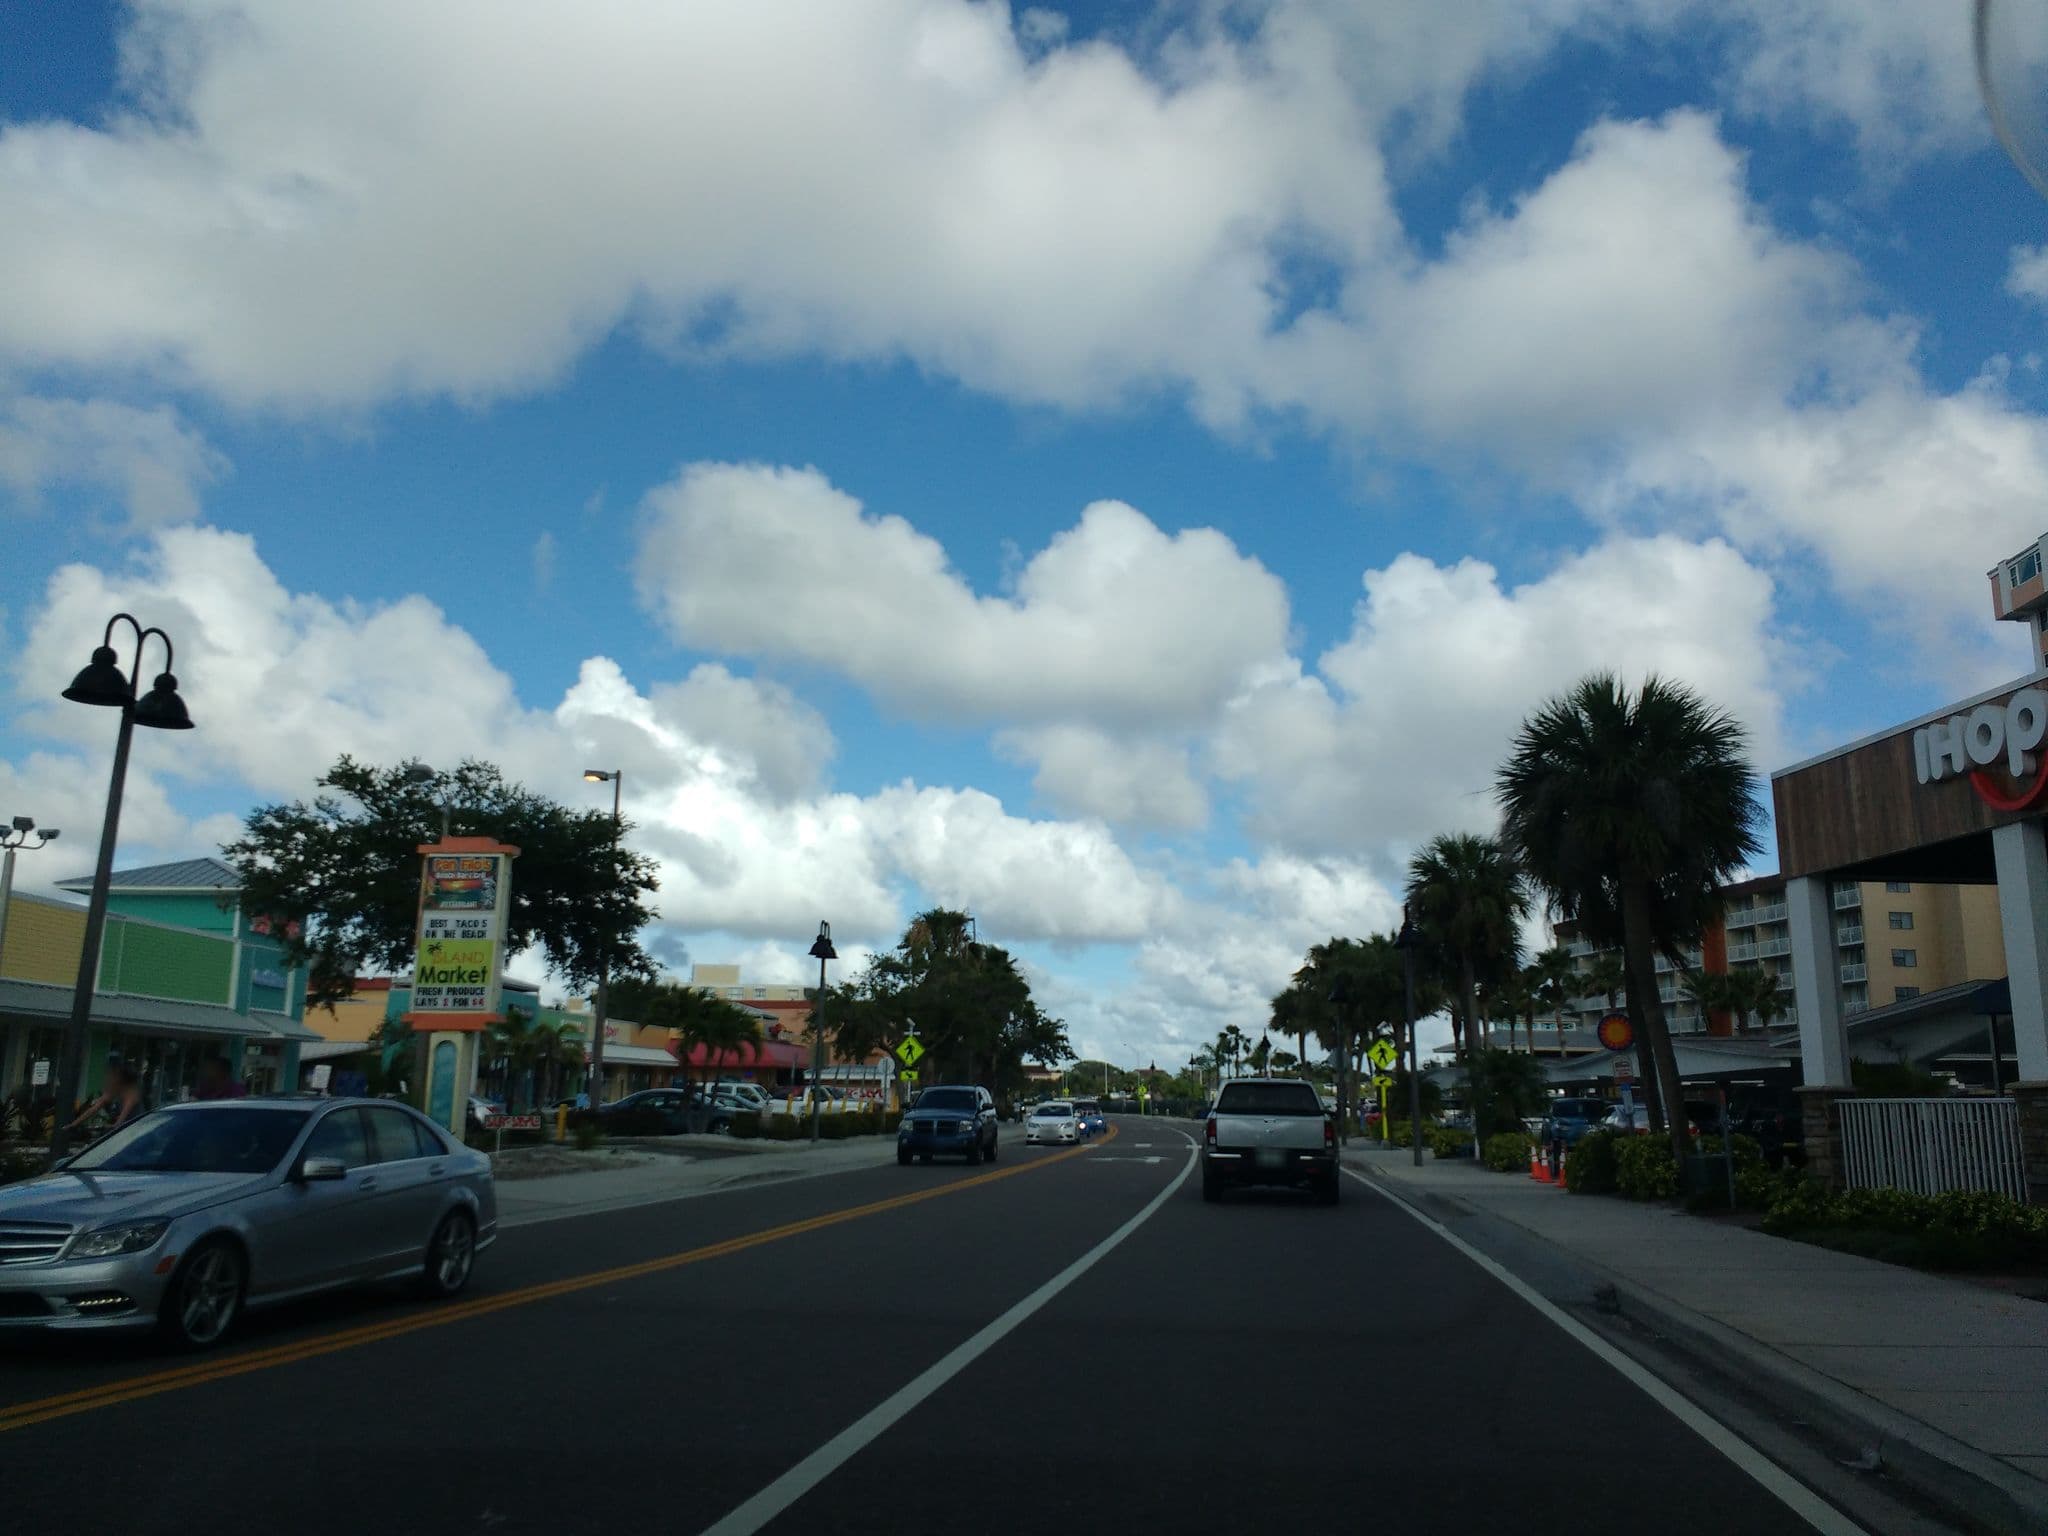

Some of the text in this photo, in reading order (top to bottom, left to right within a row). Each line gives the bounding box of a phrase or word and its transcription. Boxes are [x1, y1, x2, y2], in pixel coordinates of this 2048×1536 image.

[430, 919, 448, 928] BEST
[444, 929, 457, 938] THE
[462, 929, 488, 938] BEACH
[418, 965, 489, 983] Market
[416, 987, 486, 996] FRESH PRODUCE
[415, 998, 438, 1007] LAYS
[452, 998, 469, 1007] FOR
